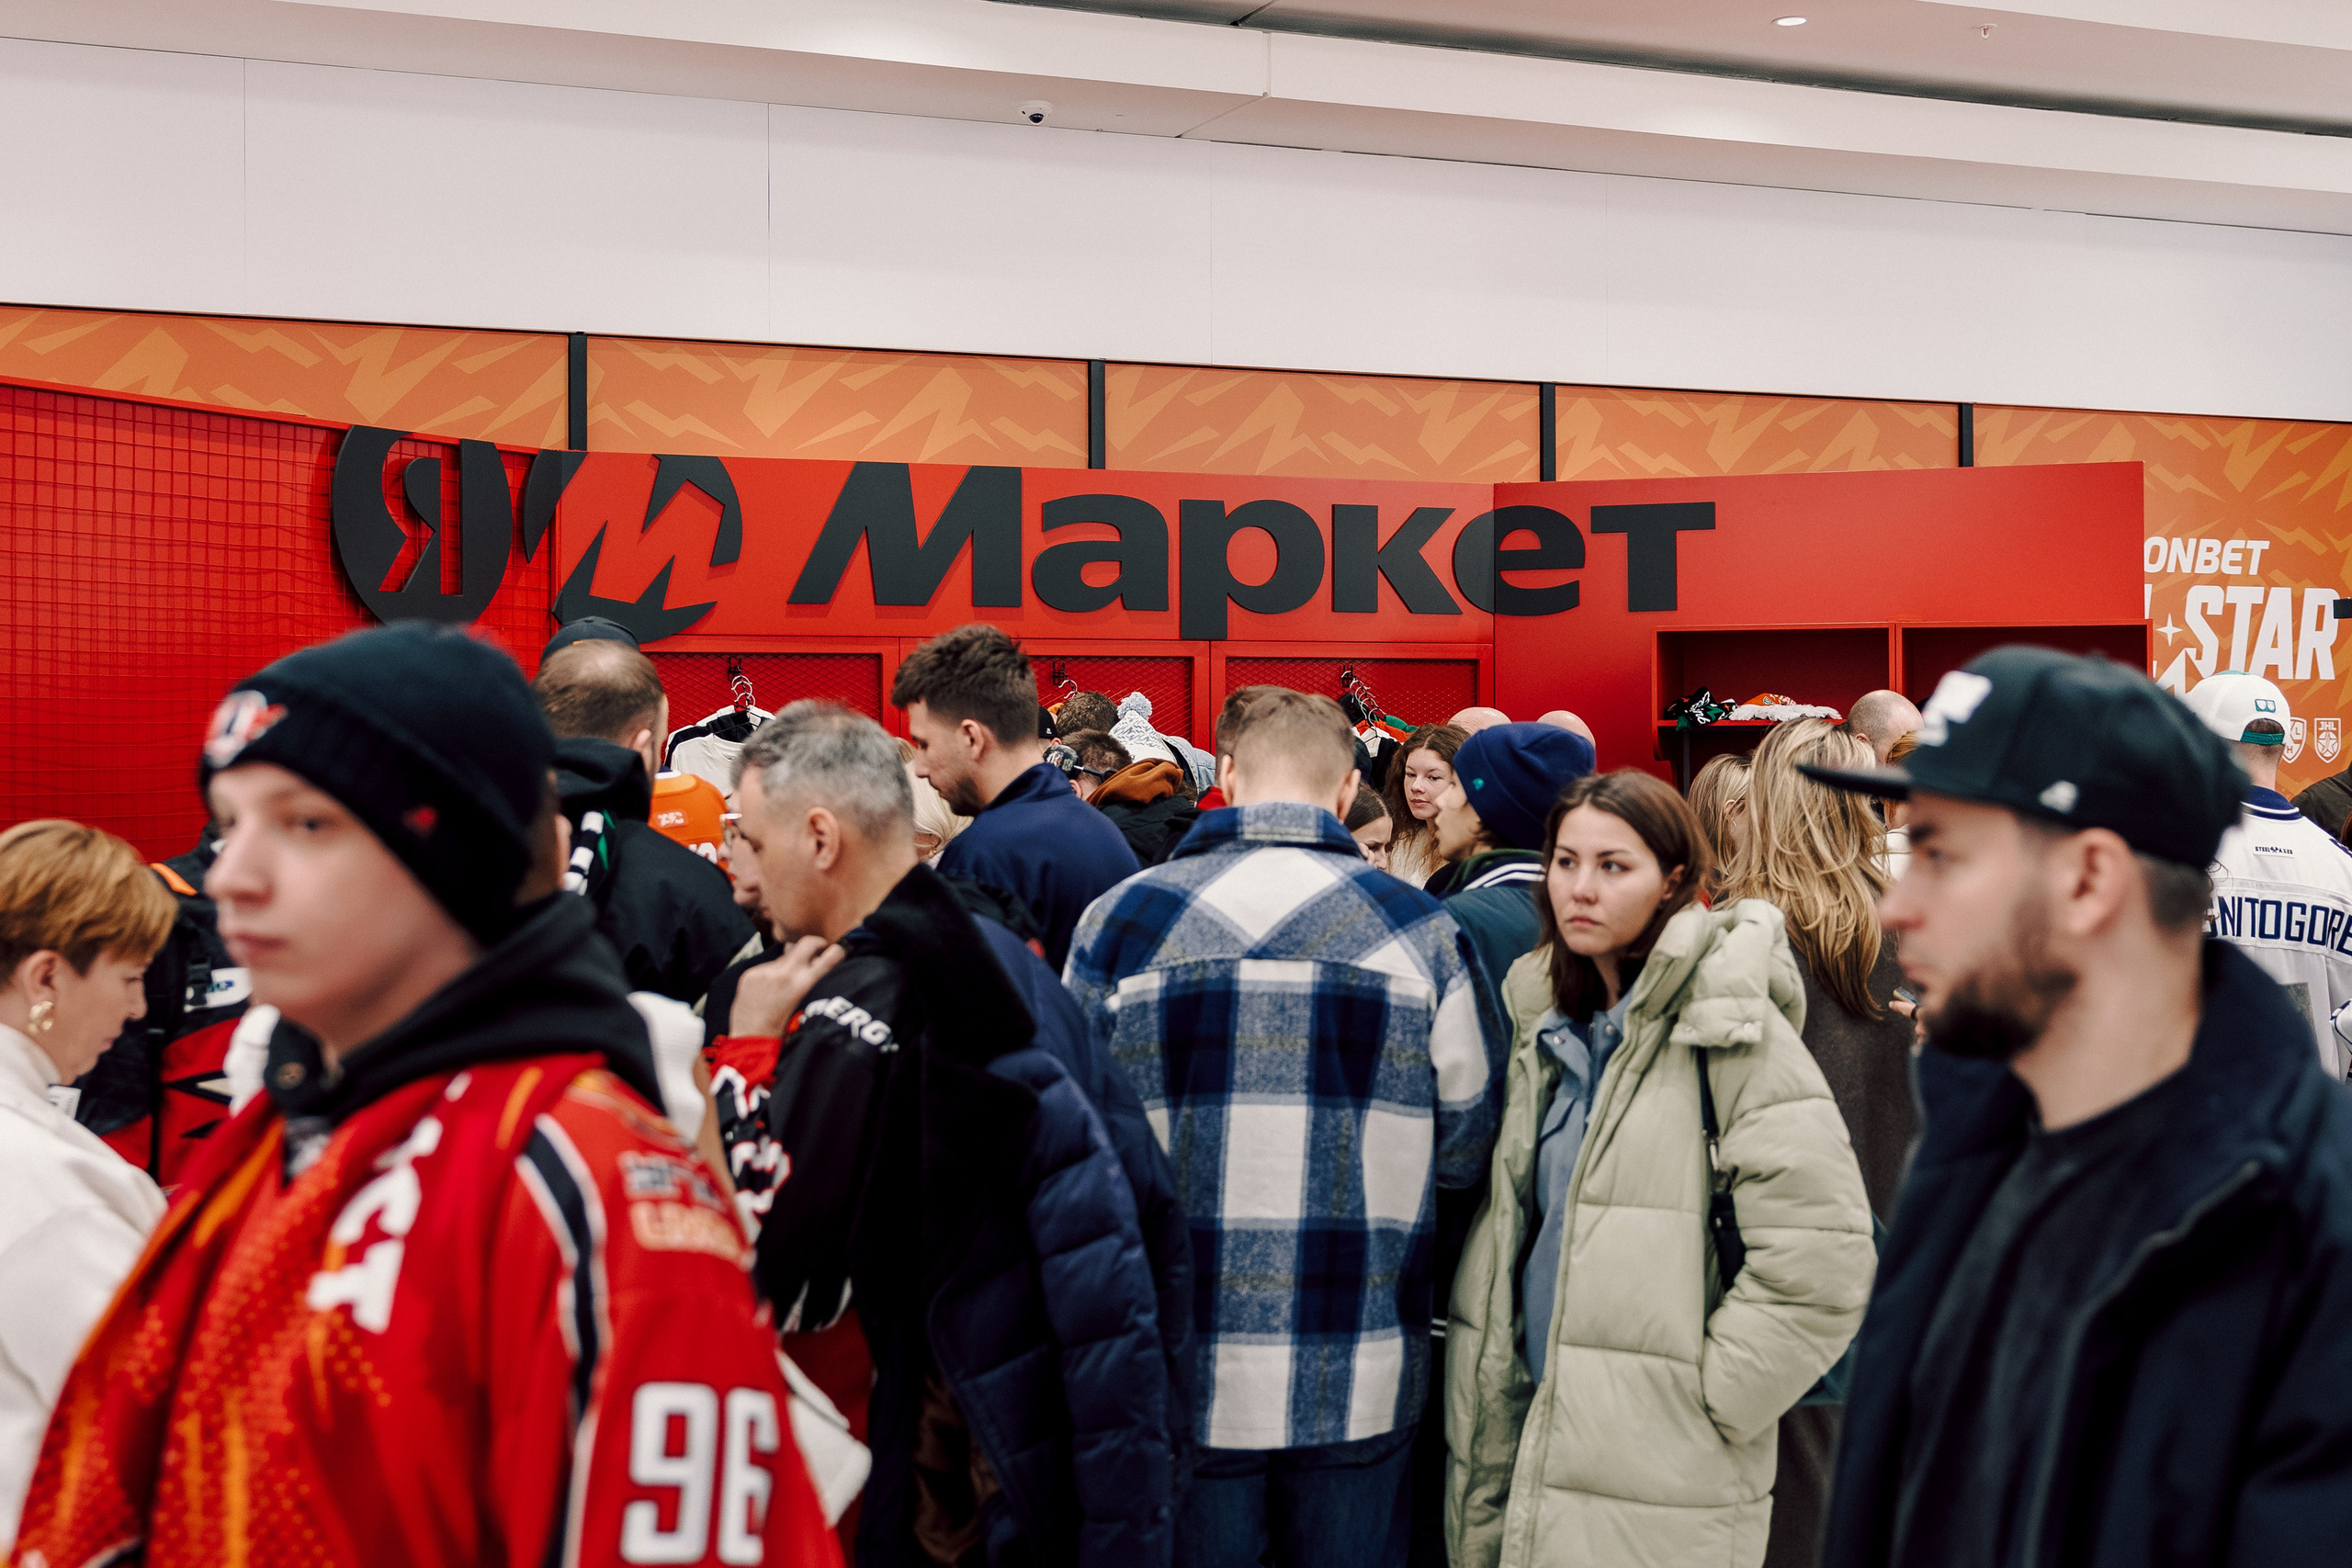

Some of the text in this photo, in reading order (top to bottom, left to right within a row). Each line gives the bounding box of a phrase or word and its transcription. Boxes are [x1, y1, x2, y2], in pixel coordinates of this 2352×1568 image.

[787, 461, 1716, 640] Маркет
[2144, 536, 2270, 575] ONBET
[2184, 585, 2340, 681] STAR
[2318, 721, 2337, 731] JHL
[619, 1381, 781, 1567] 96
